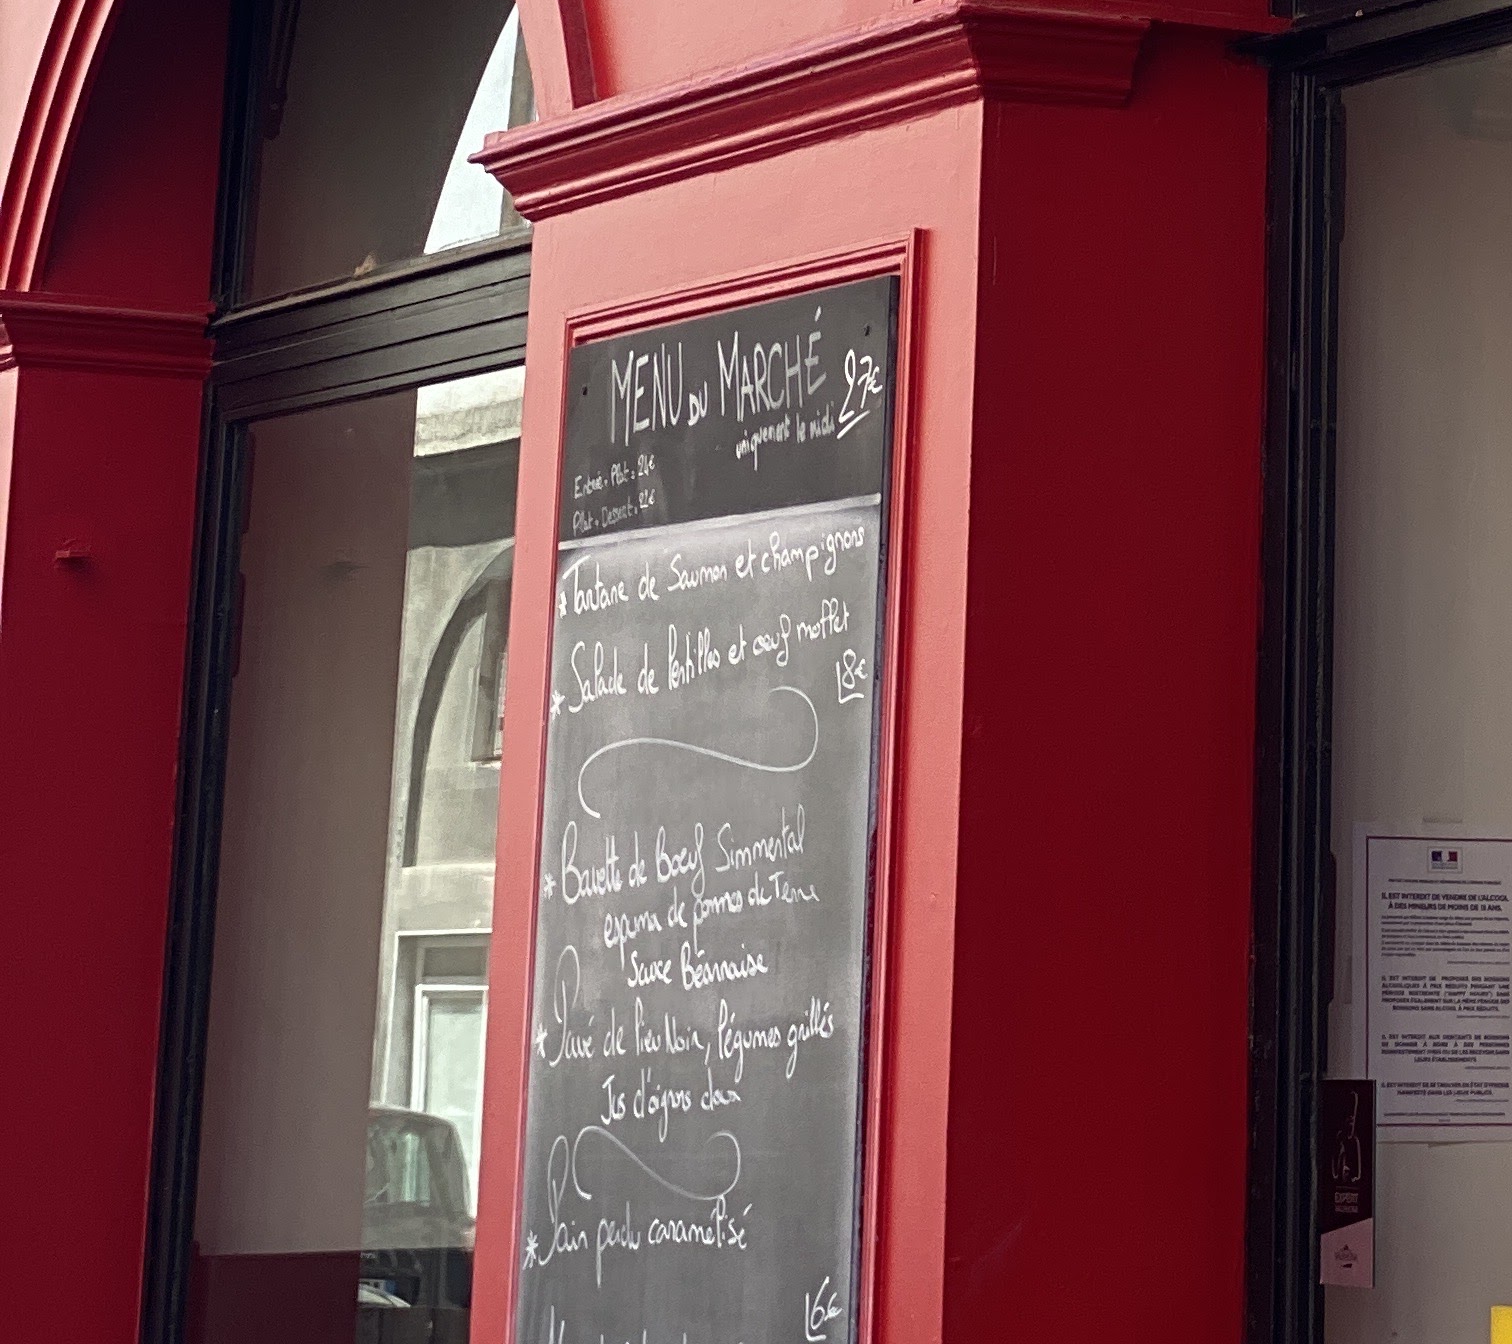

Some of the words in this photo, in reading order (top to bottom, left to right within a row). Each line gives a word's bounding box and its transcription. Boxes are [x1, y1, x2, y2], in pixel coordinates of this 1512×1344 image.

[611, 342, 683, 446] MENU
[687, 381, 708, 426] DU
[717, 305, 827, 422] MARCHÉ
[838, 348, 883, 424] 27€
[735, 414, 789, 471] uniquement
[796, 412, 806, 444] le
[809, 401, 835, 440] midi
[562, 556, 629, 615] Tartare
[638, 562, 659, 601] de
[667, 554, 728, 592] Saumon
[736, 538, 756, 578] et
[761, 527, 865, 582] champignons
[568, 641, 628, 713] Salade
[637, 642, 659, 695] de
[668, 623, 721, 691] lentilles
[728, 624, 747, 665] et
[797, 597, 850, 642] mollet
[561, 821, 623, 905] Bavette
[628, 830, 648, 887] de
[715, 803, 806, 872] Simmental
[667, 886, 687, 927] de
[693, 894, 743, 955] pommes
[748, 870, 772, 906] de
[769, 870, 820, 903] Terre
[627, 950, 672, 988] Sauce
[680, 941, 769, 990] Béarnaise
[549, 944, 595, 1068] Pavé
[603, 1007, 626, 1058] de
[787, 995, 834, 1079] grillés
[601, 1075, 627, 1126] Jus
[702, 1066, 741, 1111] doux
[538, 1135, 589, 1265] Pain
[596, 1201, 640, 1287] perdu
[649, 1195, 752, 1249] caramélisé
